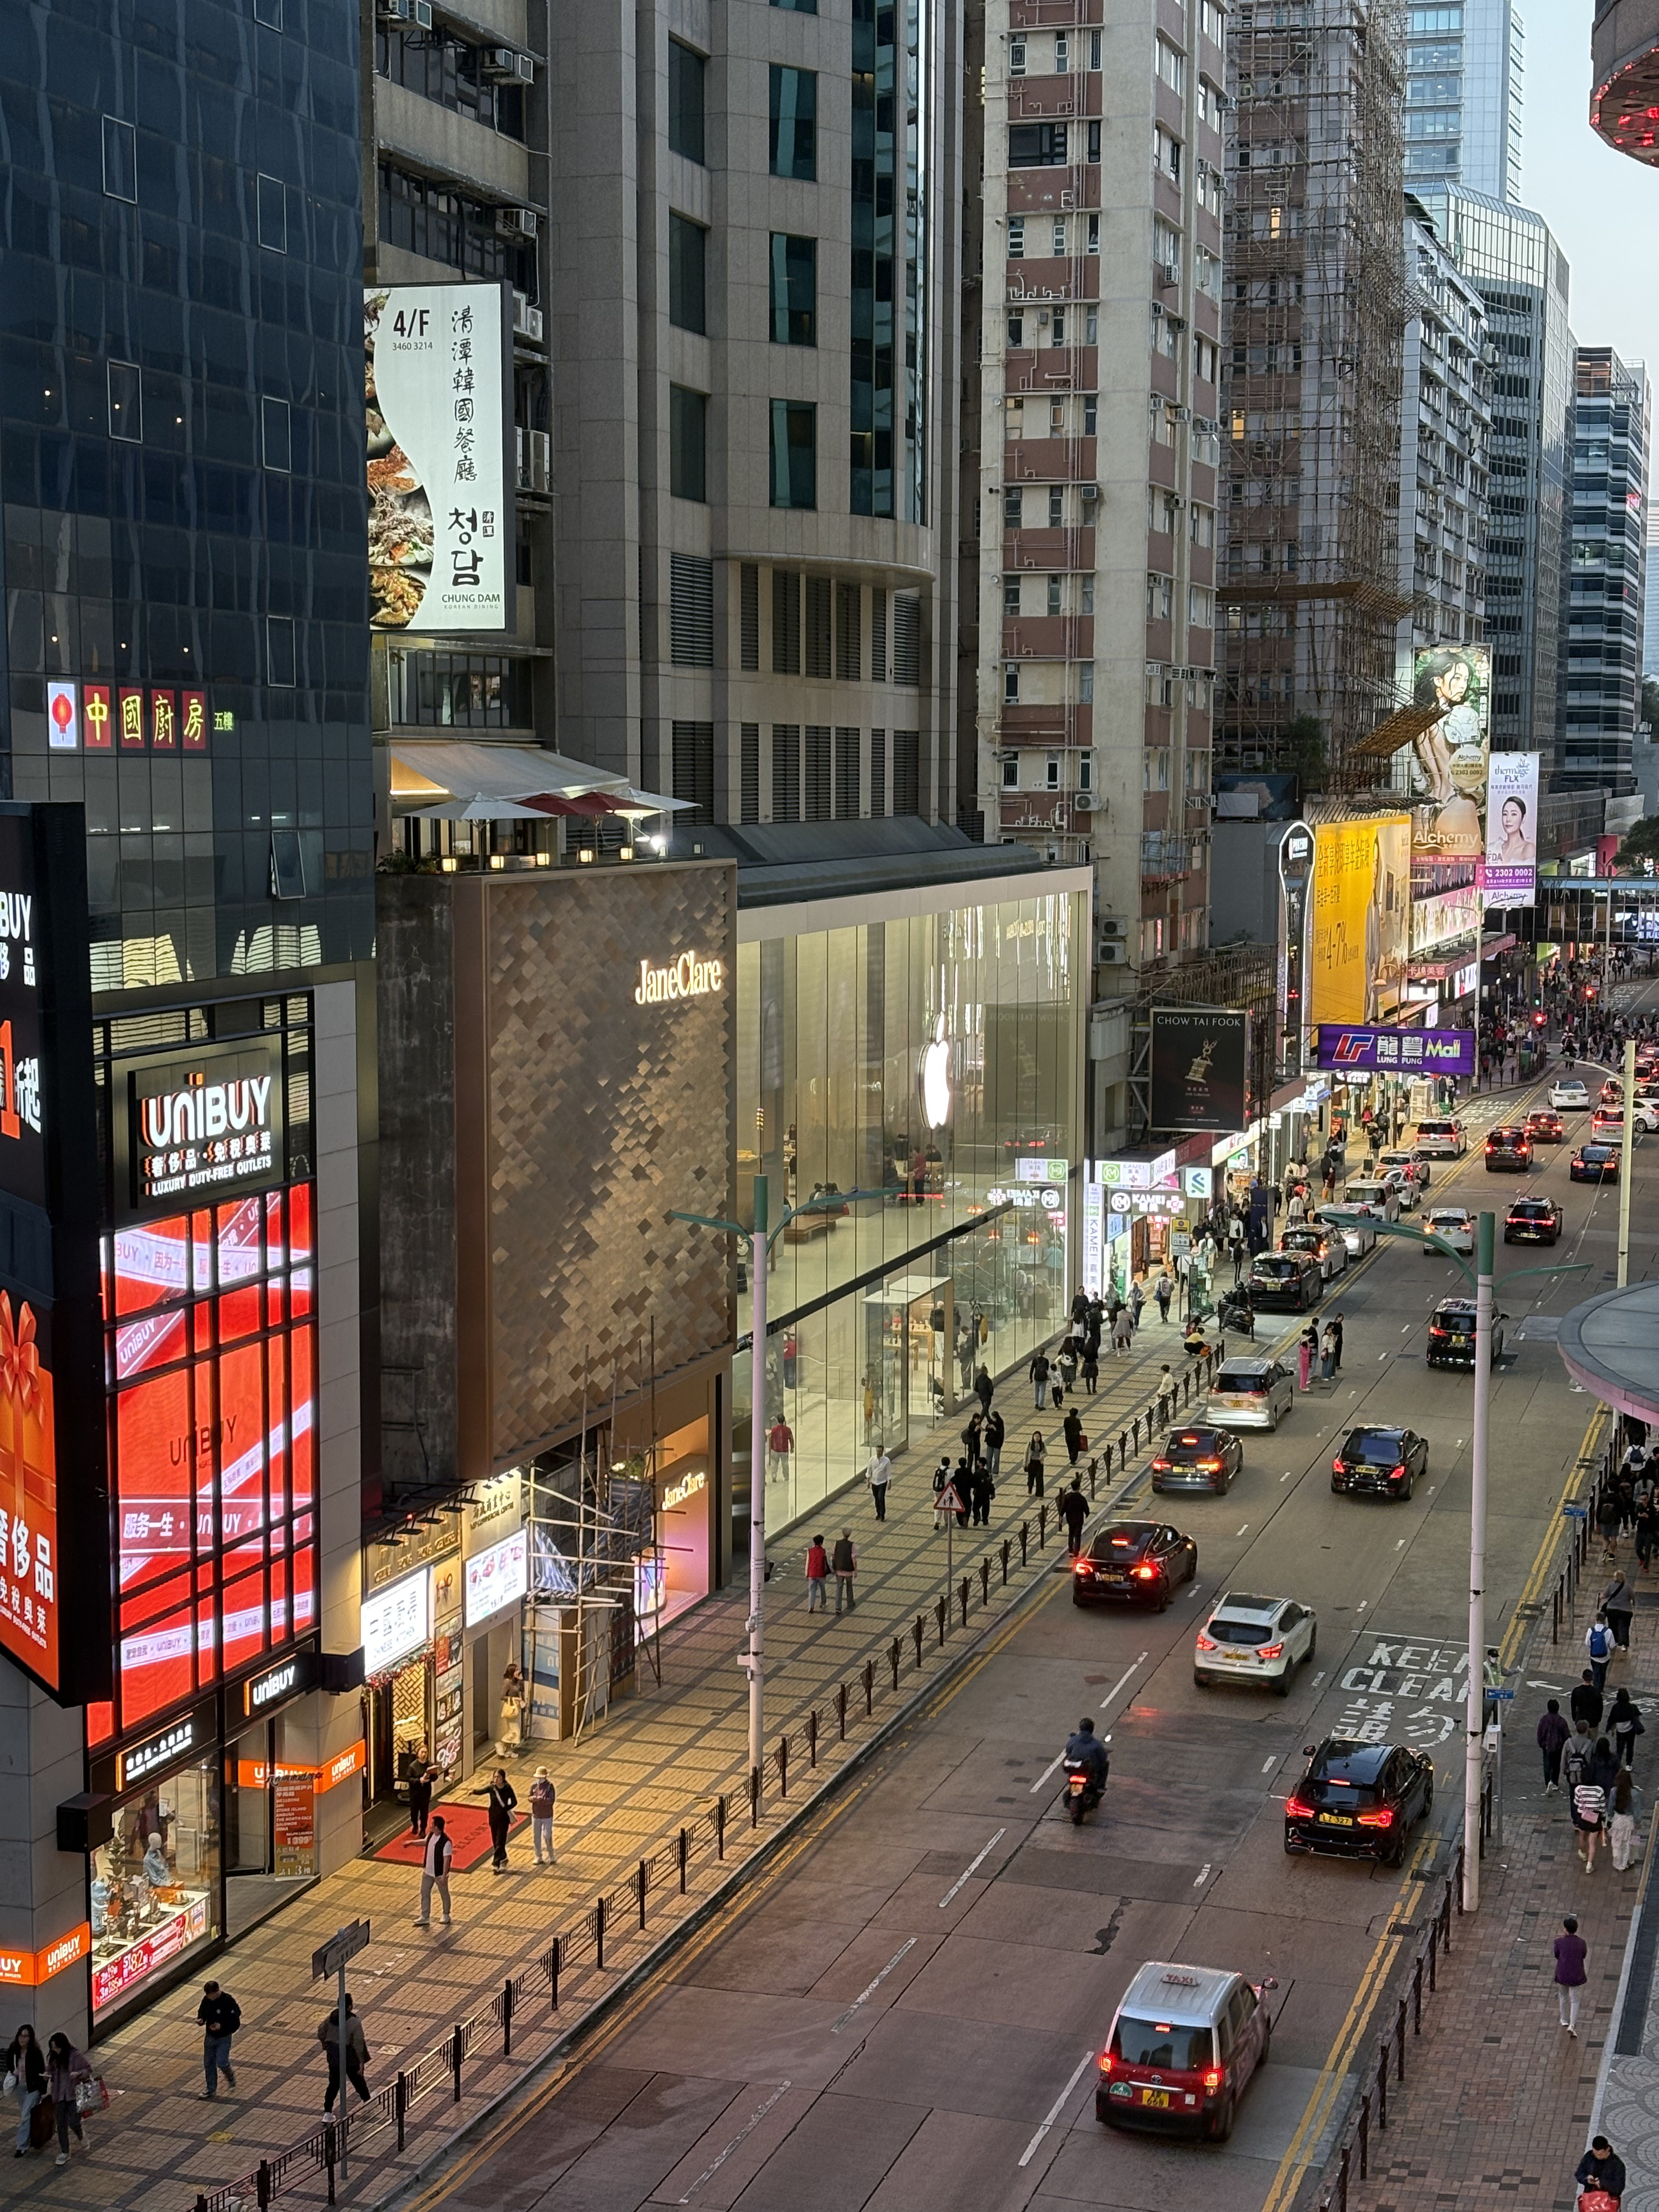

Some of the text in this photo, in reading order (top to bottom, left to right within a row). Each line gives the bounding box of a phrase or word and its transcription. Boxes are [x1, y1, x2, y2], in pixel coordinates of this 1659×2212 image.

[393, 309, 430, 337] 4/F
[393, 341, 433, 351] 3460 3214
[447, 507, 484, 587] 청담
[442, 593, 500, 604] CHUNG DAM
[86, 692, 205, 744] 中國廚房
[1412, 830, 1479, 848] Alchemy
[1488, 853, 1503, 862] FDA
[1495, 868, 1533, 877] 2302 0002
[1157, 1016, 1241, 1026] CHOW TAI FOOK
[1425, 1038, 1460, 1058] Mall
[150, 1176, 186, 1196] LUXURY
[236, 1155, 272, 1175] OUTLETS
[1089, 1219, 1098, 1256] KAMEI
[123, 1512, 174, 1538] 服务一生
[1166, 1973, 1193, 1984] TAXI
